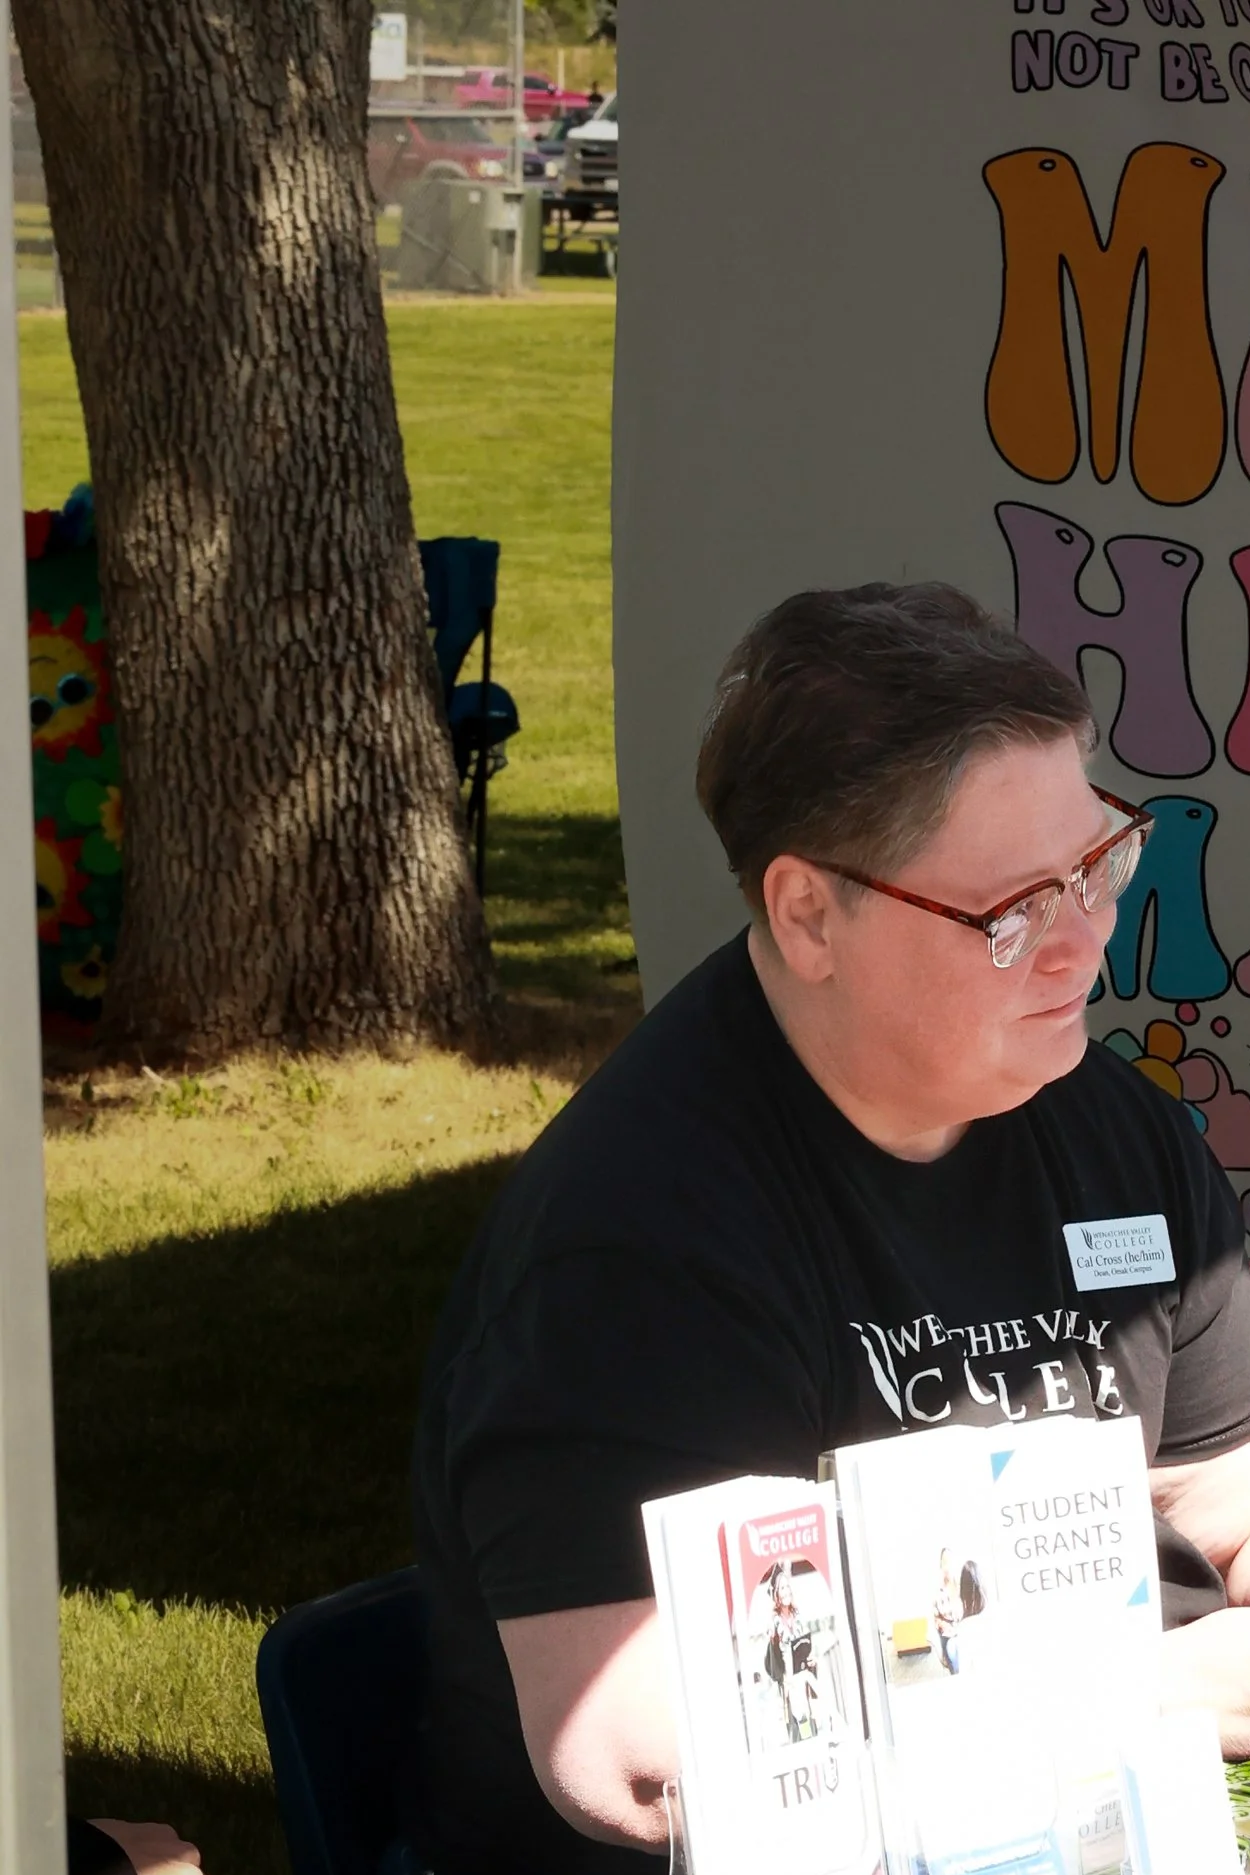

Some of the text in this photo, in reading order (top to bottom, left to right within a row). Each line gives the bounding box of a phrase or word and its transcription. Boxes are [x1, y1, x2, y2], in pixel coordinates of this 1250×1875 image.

[1012, 30, 1139, 93] NOT
[1160, 41, 1229, 103] BE
[1076, 1248, 1166, 1269] Cal Cross (he/him)
[1094, 1235, 1154, 1250] COLLEGE
[1001, 1486, 1124, 1528] STUDENT
[760, 1526, 819, 1557] COLLEGE
[1014, 1522, 1122, 1560] GRANTS
[1021, 1556, 1124, 1594] CENTER
